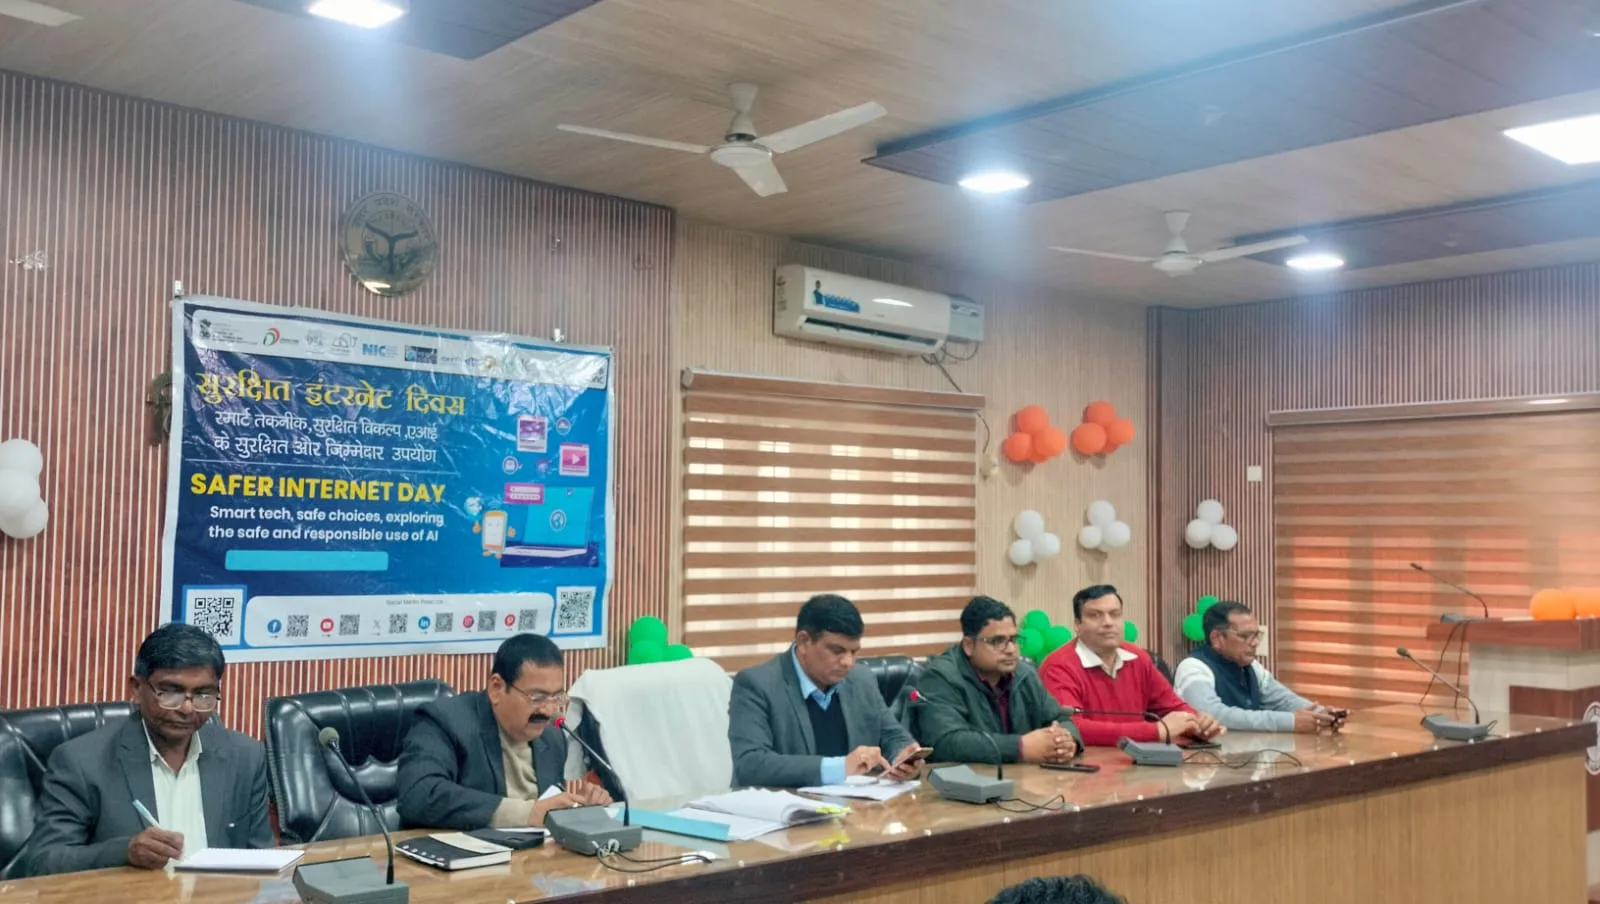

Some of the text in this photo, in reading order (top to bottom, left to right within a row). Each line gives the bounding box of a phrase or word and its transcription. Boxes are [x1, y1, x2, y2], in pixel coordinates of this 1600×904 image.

[196, 369, 466, 415] सुरक्षित इंटरनेट दिवस
[360, 417, 401, 437] विकल्प
[214, 431, 230, 450] के
[235, 433, 289, 458] सुरक्षित
[293, 435, 320, 456] और
[190, 473, 446, 503] SAFER INTERNET DAY
[210, 506, 444, 527] Smart tech, safe choices, exploring
[208, 525, 438, 543] the safe and responsible use of AI
